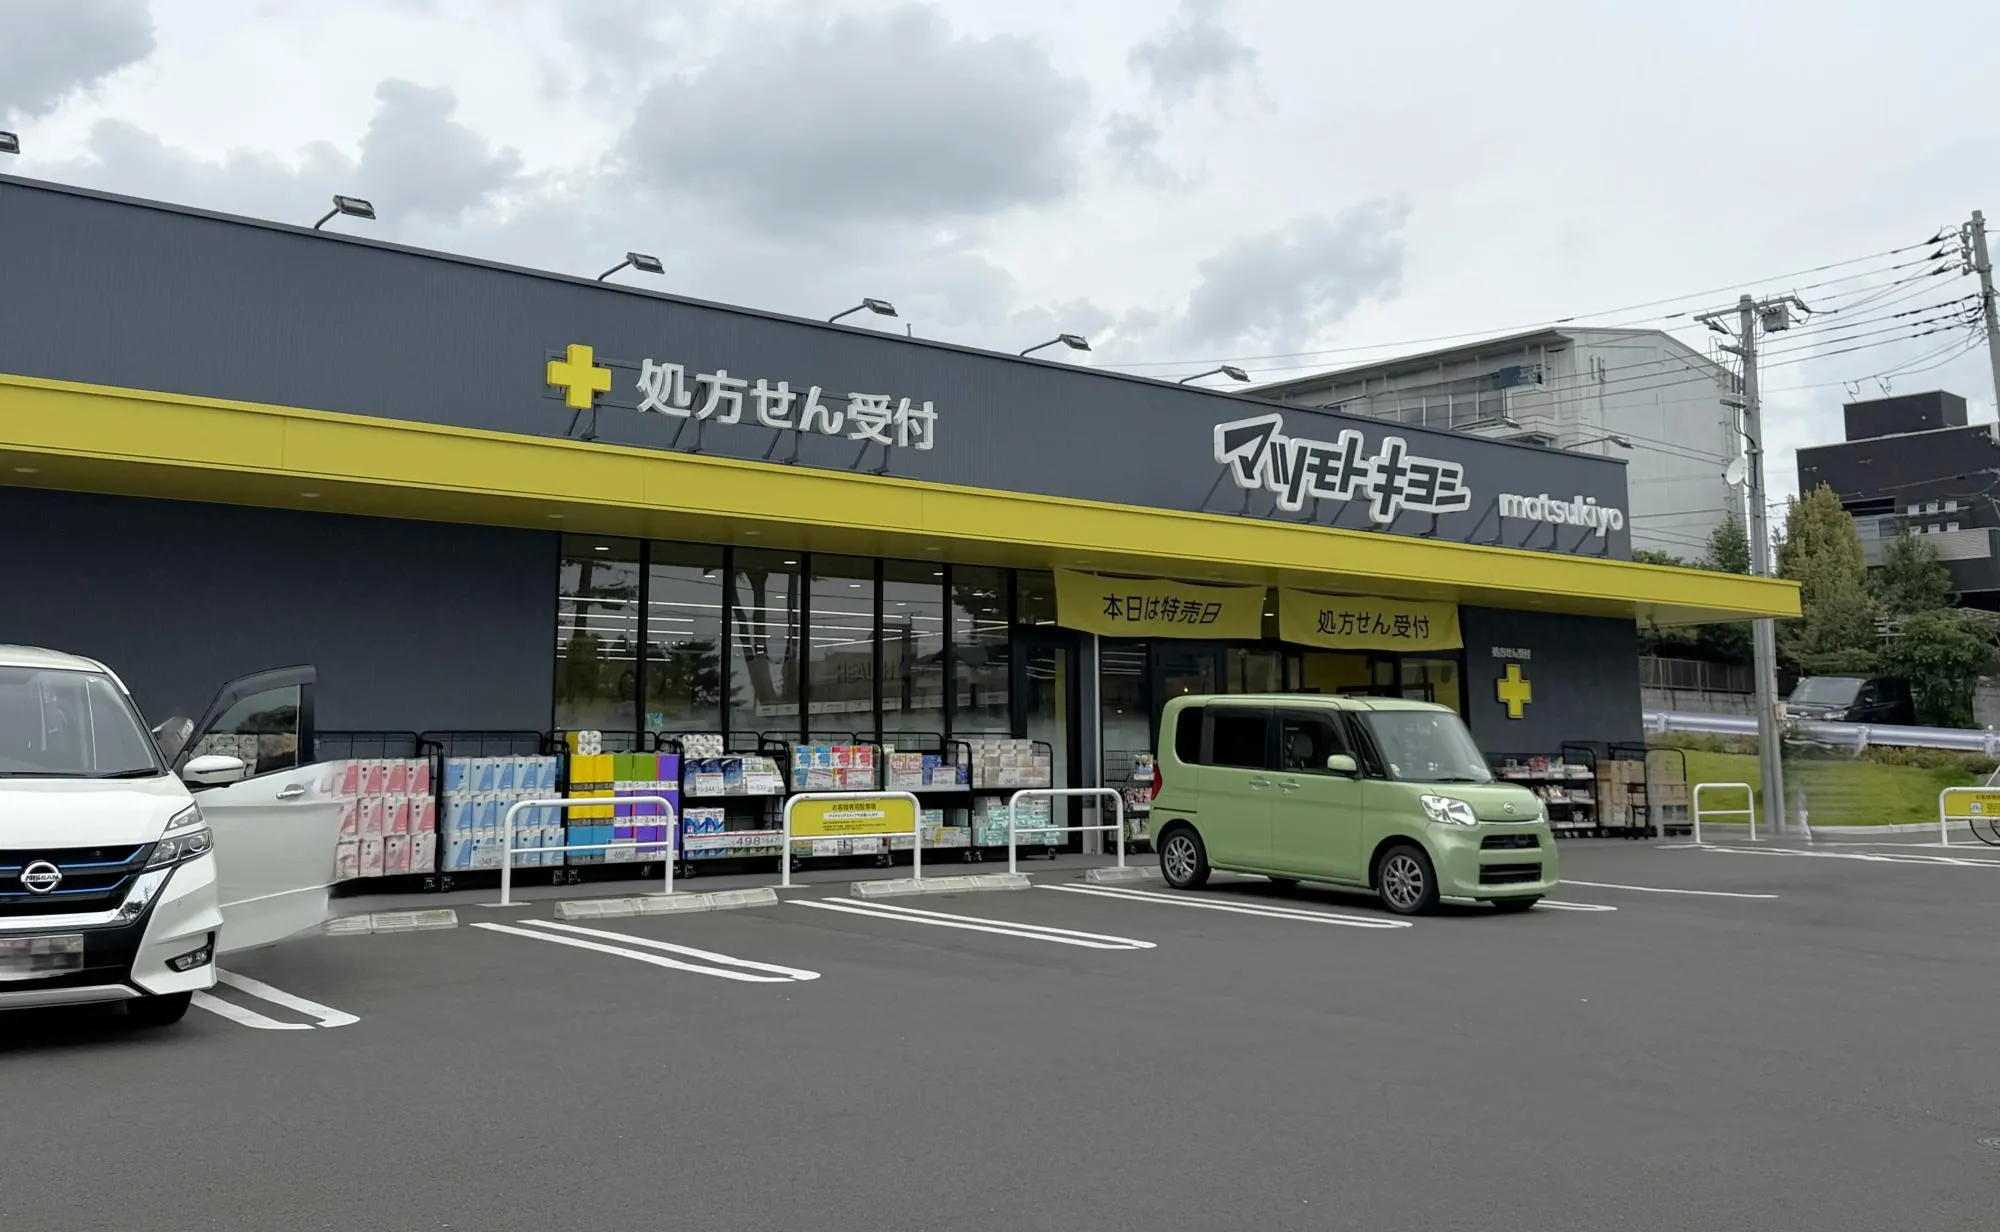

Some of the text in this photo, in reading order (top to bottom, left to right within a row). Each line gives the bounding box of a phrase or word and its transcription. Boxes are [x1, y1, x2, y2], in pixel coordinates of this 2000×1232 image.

[635, 358, 939, 450] 処方せん受付
[1214, 414, 1471, 523] マツモトキヨシ
[1499, 493, 1624, 537] matsukiyo
[1102, 592, 1223, 625] 本日は特売日
[1317, 609, 1430, 639] 処方せん受付
[736, 837, 761, 845] 498
